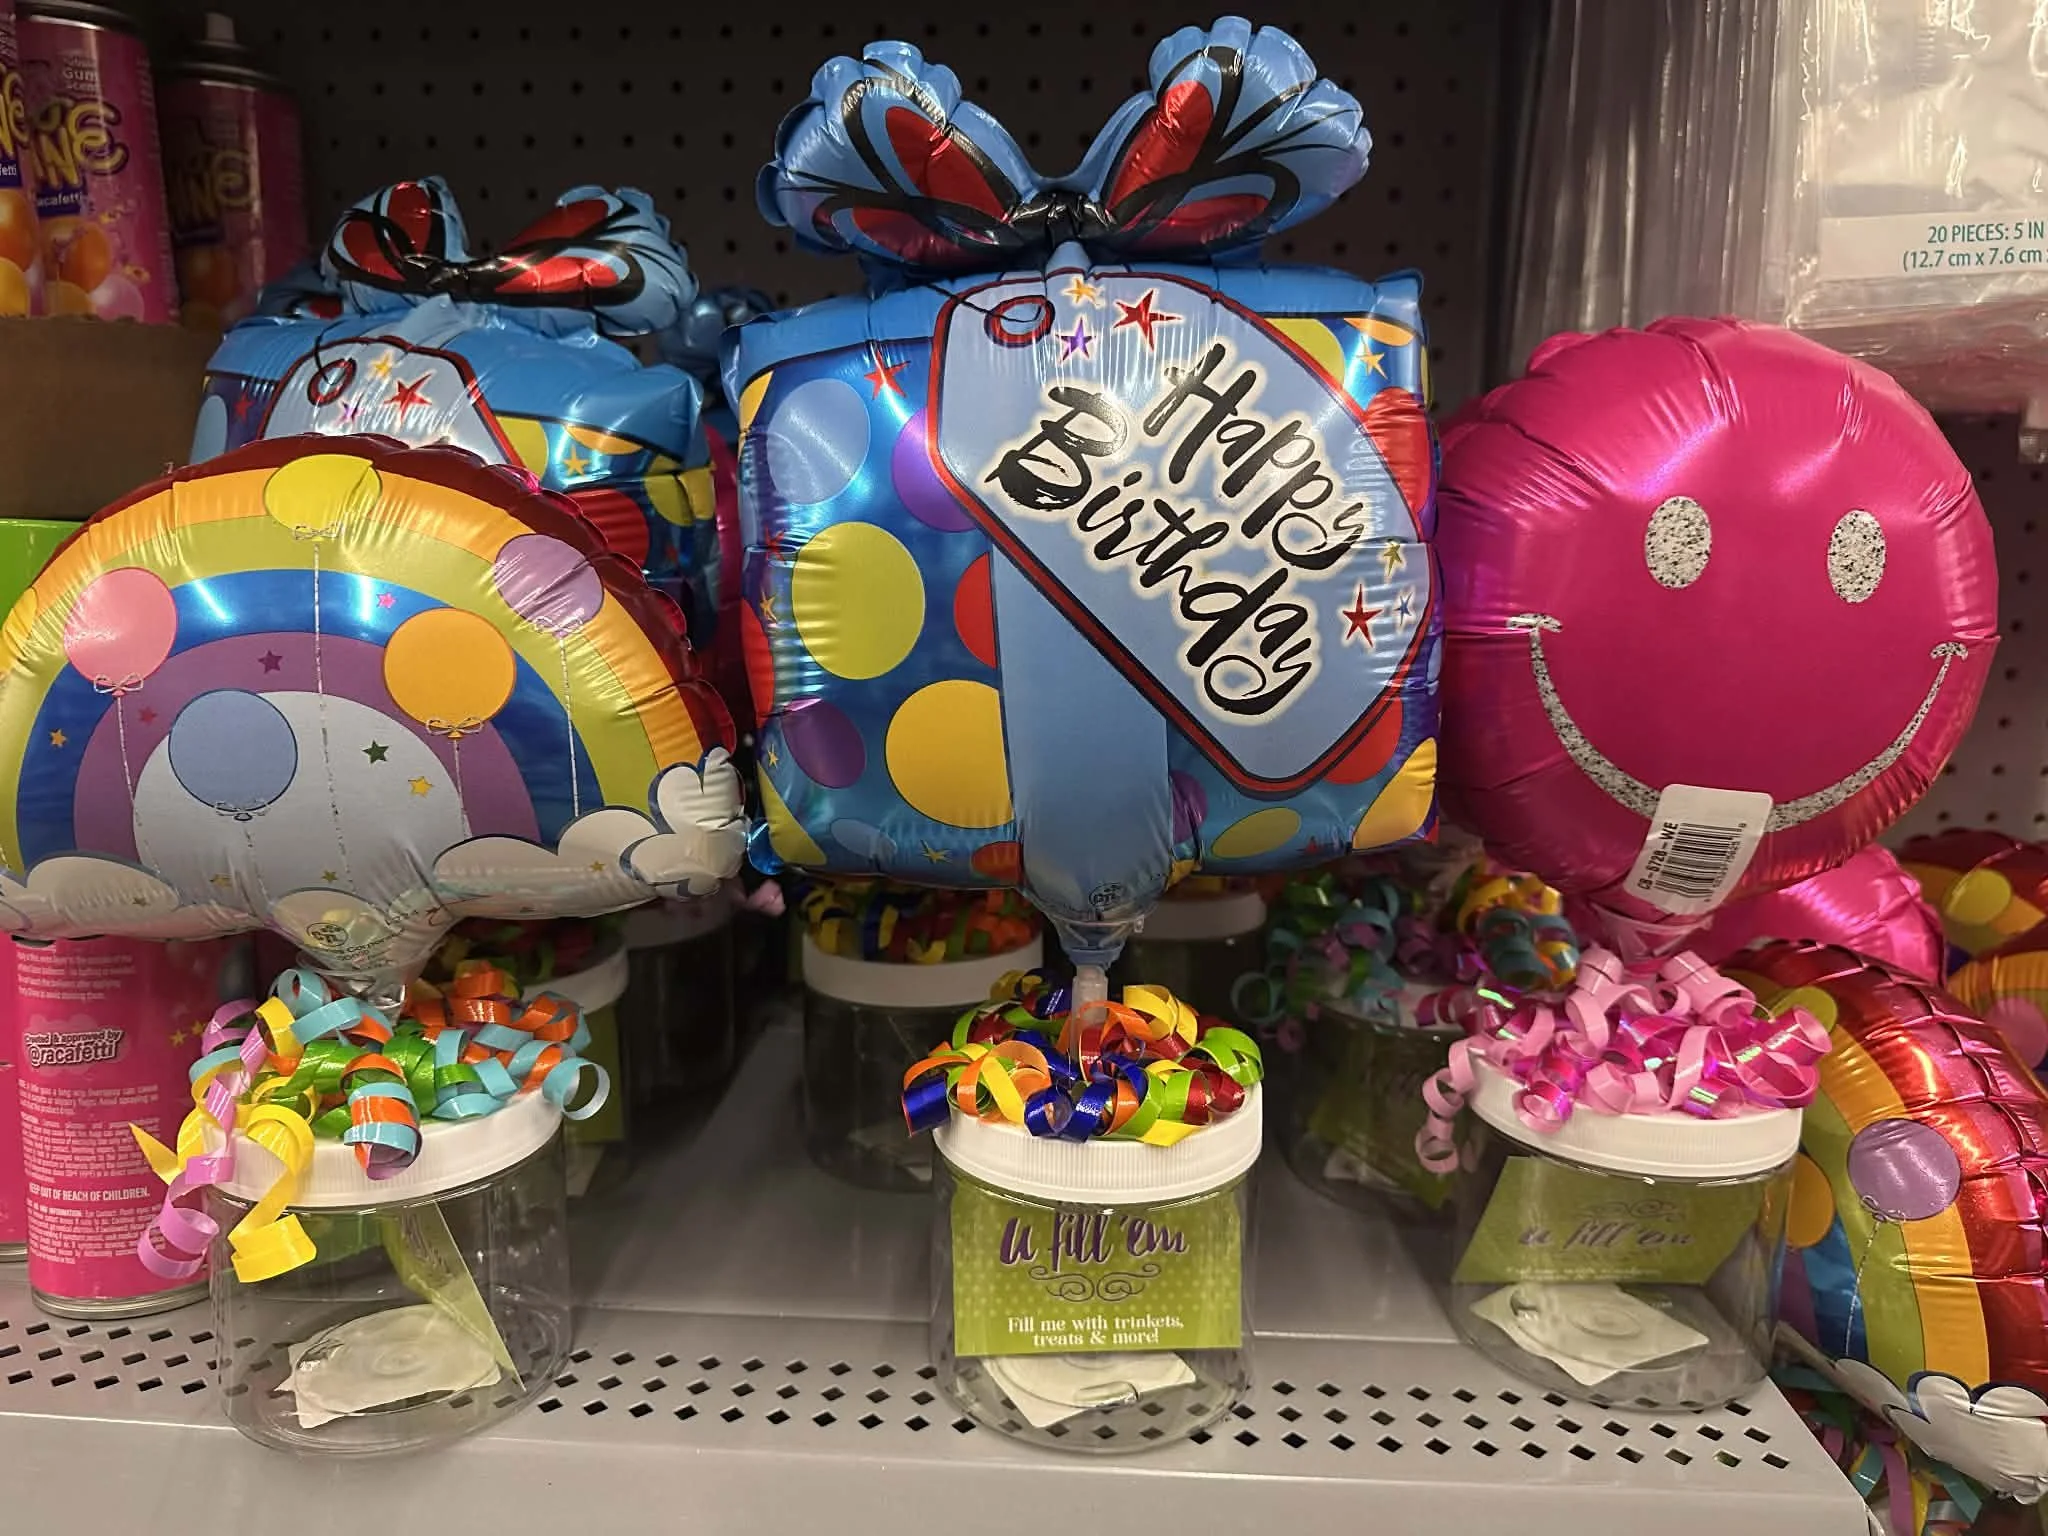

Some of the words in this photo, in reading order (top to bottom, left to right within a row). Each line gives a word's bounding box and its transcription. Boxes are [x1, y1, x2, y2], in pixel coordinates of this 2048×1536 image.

[1928, 225, 1947, 244] 20
[1952, 223, 2009, 243] PIECES:
[2013, 222, 2024, 240] 5
[2028, 220, 2044, 240] IN
[1903, 249, 1943, 272] (12.7
[1948, 252, 1971, 268] cm
[1975, 252, 1985, 266] x
[1989, 247, 2014, 265] 7.6
[2019, 248, 2042, 264] cm
[1143, 343, 1364, 570] Happy
[984, 386, 1313, 716] Birthday
[105, 1028, 123, 1042] by
[29, 1041, 117, 1066] @racafetti
[53, 1187, 62, 1200] OF
[63, 1189, 89, 1201] REACH
[90, 1190, 101, 1201] OF
[102, 1186, 150, 1201] CHILDREN.
[1050, 1206, 1113, 1273] fill
[1008, 1315, 1034, 1334] Fill
[1040, 1318, 1066, 1332] me
[1072, 1314, 1108, 1331] with
[1114, 1313, 1184, 1330] trinkets,
[1034, 1332, 1083, 1347] treats
[1089, 1330, 1106, 1345] &
[1113, 1327, 1159, 1345] more!
